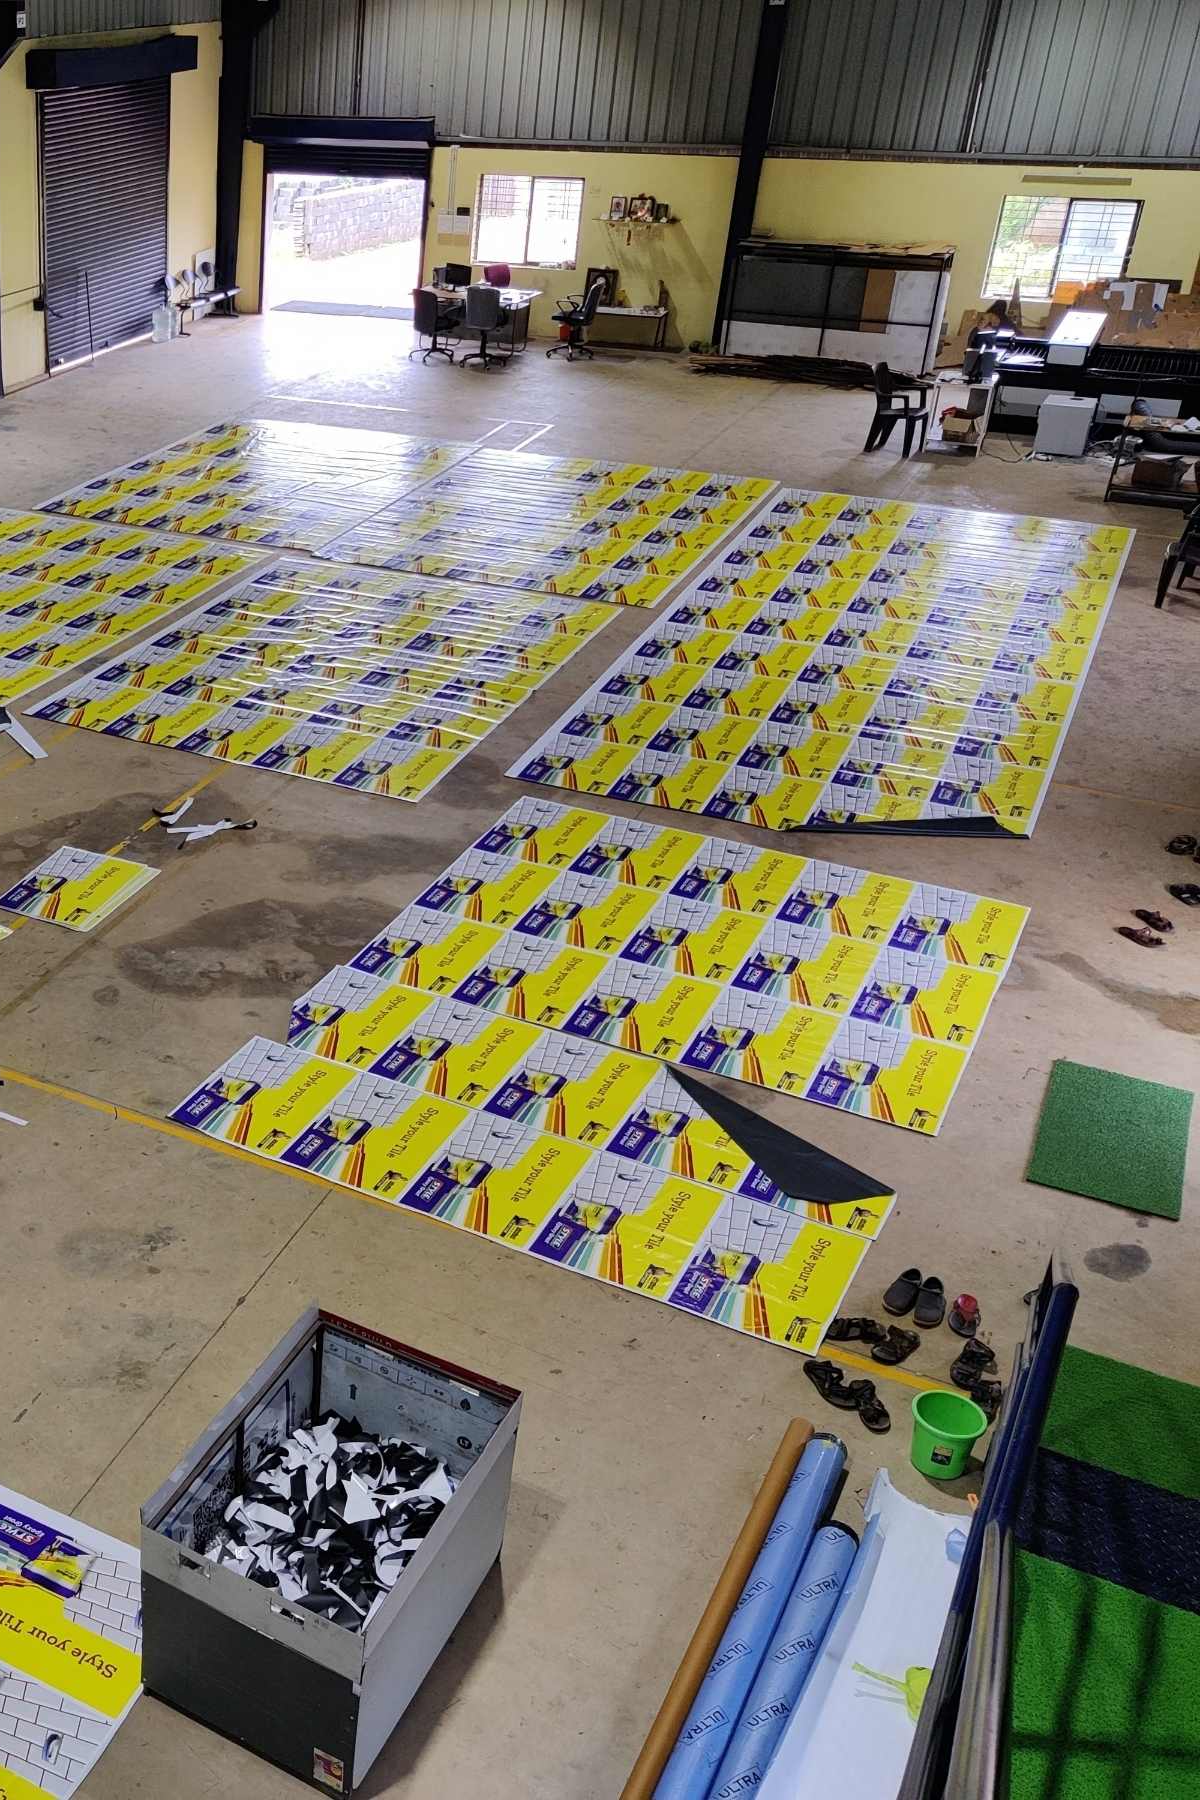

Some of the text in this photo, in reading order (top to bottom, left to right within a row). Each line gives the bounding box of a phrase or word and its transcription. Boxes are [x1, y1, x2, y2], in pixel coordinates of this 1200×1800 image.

[271, 1069, 327, 1118] Style your Tile
[415, 1106, 439, 1126] Style
[399, 1124, 421, 1144] your
[385, 1143, 409, 1158] Tile
[537, 1147, 561, 1168] Style
[522, 1165, 543, 1187] your
[509, 1186, 533, 1202] Tile
[668, 1190, 691, 1213] Style
[654, 1210, 675, 1233] your
[643, 1233, 666, 1250] Tile
[808, 1237, 831, 1260] Style
[796, 1258, 816, 1283] your
[786, 1282, 809, 1301] Tile
[801, 1578, 839, 1598] ULTRA
[28, 1626, 75, 1654] your
[775, 1638, 815, 1660] ULTRA
[73, 1648, 121, 1681] Style
[685, 1710, 725, 1740] ULTRA
[748, 1703, 790, 1727] ULTRA
[719, 1772, 761, 1800] ULTRA
